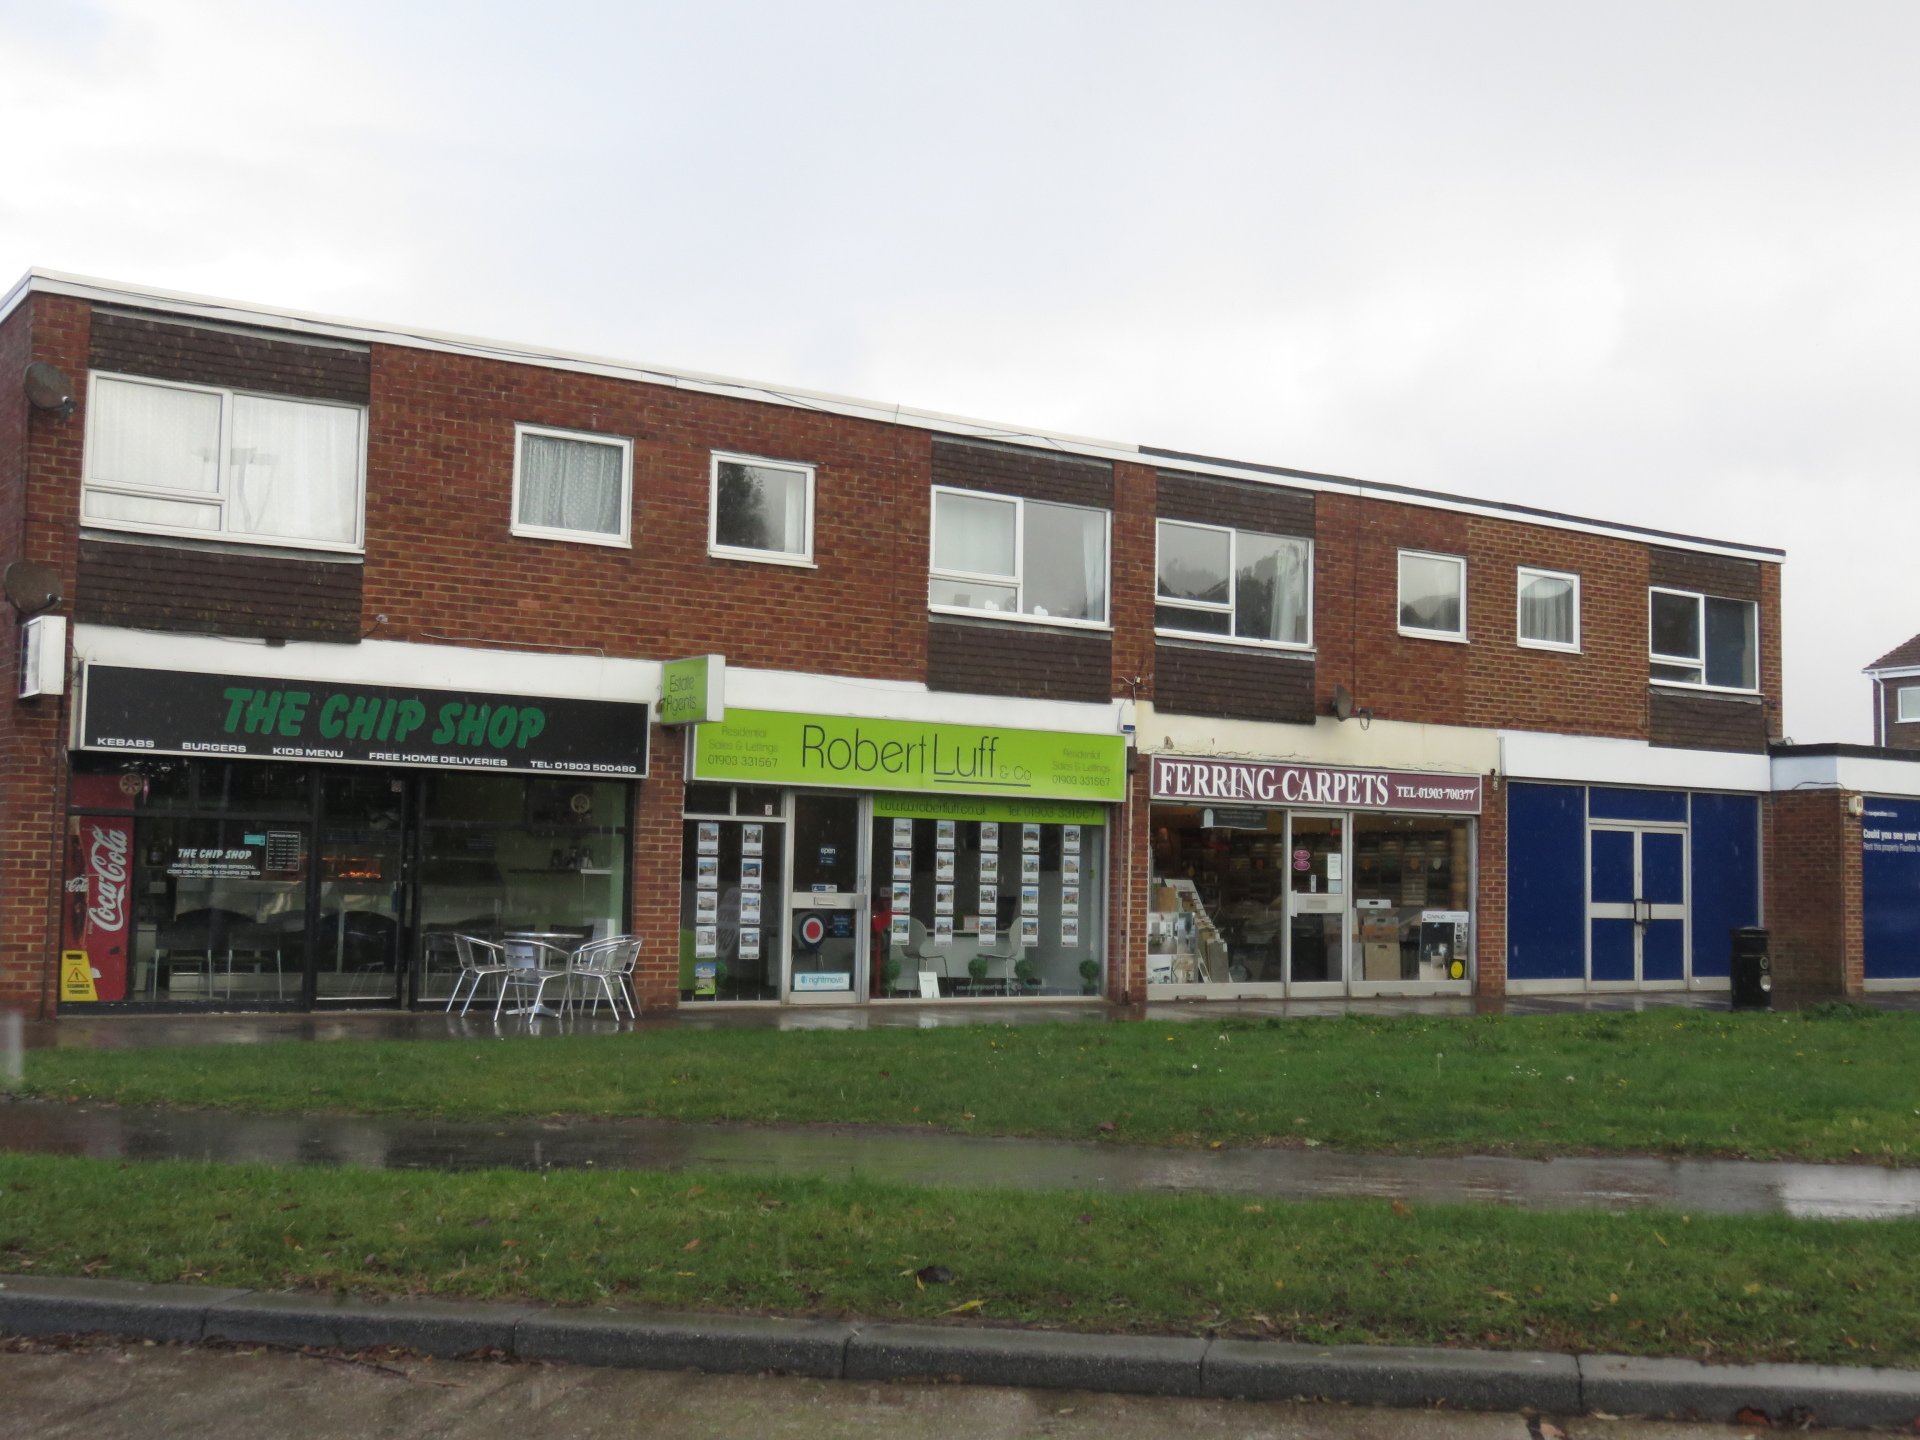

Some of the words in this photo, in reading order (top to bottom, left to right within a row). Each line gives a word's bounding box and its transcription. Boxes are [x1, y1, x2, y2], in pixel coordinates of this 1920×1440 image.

[669, 674, 695, 692] Estate
[666, 694, 697, 716] Agents
[223, 687, 311, 737] THE
[319, 693, 426, 743] CHIP
[431, 702, 546, 749] SHOP
[721, 726, 767, 738] Residential
[709, 739, 733, 750] Sales
[745, 741, 779, 754] Lettings
[802, 724, 927, 774] Robert
[933, 733, 999, 778] Luff
[999, 764, 1009, 779] &
[1013, 765, 1032, 780] Co
[97, 737, 155, 748] KEBABS
[182, 742, 247, 753] BURGERS
[272, 747, 303, 756] KIDS
[305, 749, 344, 758] MENU
[369, 752, 400, 761] FREE
[402, 754, 438, 763] HOME
[440, 756, 508, 767] DELIVERIES
[530, 760, 553, 769] TEL:
[554, 761, 591, 771] 01903
[592, 764, 637, 773] 500480
[707, 754, 738, 766] 01903
[741, 756, 778, 768] 331567
[1051, 775, 1077, 785] 01903
[1079, 776, 1110, 787] 331567
[1158, 761, 1277, 800] FERRING
[1281, 769, 1389, 806] CARPETS
[1023, 806, 1055, 818] 01903
[1863, 828, 1880, 839] Could
[1880, 831, 1892, 841] you
[1892, 832, 1903, 840] see
[1904, 832, 1918, 842] your
[178, 848, 197, 858] THE
[199, 849, 223, 859] CHIP
[225, 850, 252, 860] SHOP
[820, 847, 836, 855] open
[88, 824, 127, 932] Coca-Cola
[808, 975, 844, 986] rightmove
